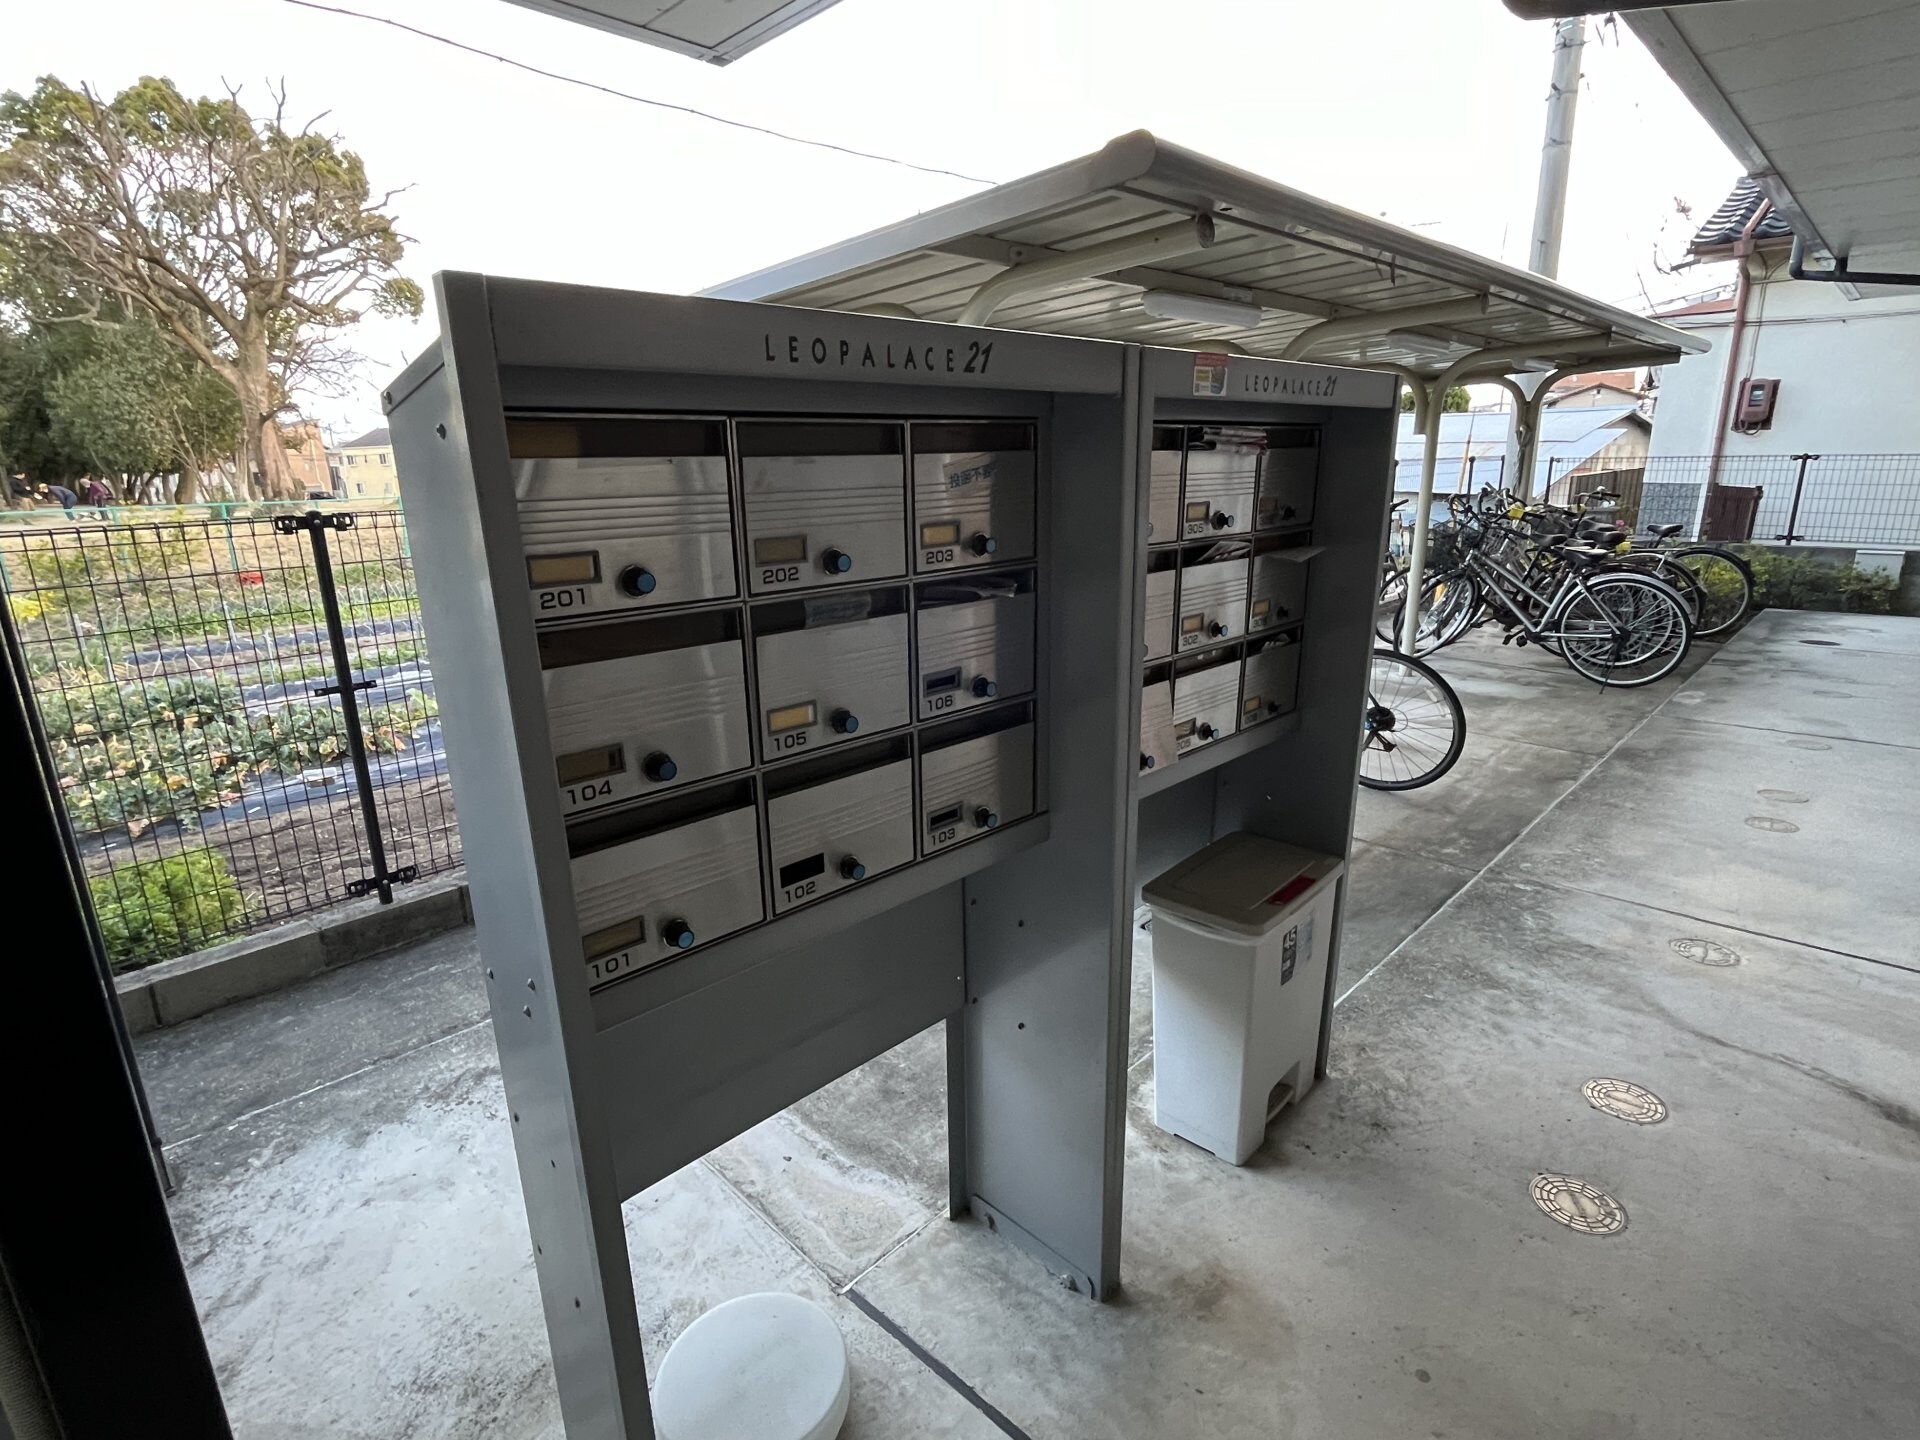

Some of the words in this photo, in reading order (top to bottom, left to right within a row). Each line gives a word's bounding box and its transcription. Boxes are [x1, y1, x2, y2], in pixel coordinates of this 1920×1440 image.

[925, 548, 954, 564] 203
[762, 566, 800, 584] 202
[540, 588, 588, 609] 201
[927, 694, 954, 712] 106
[773, 732, 807, 752] 105
[567, 780, 612, 805] 104
[930, 828, 956, 846] 103
[784, 881, 816, 903] 102
[1283, 928, 1296, 949] 45
[592, 953, 631, 980] 101
